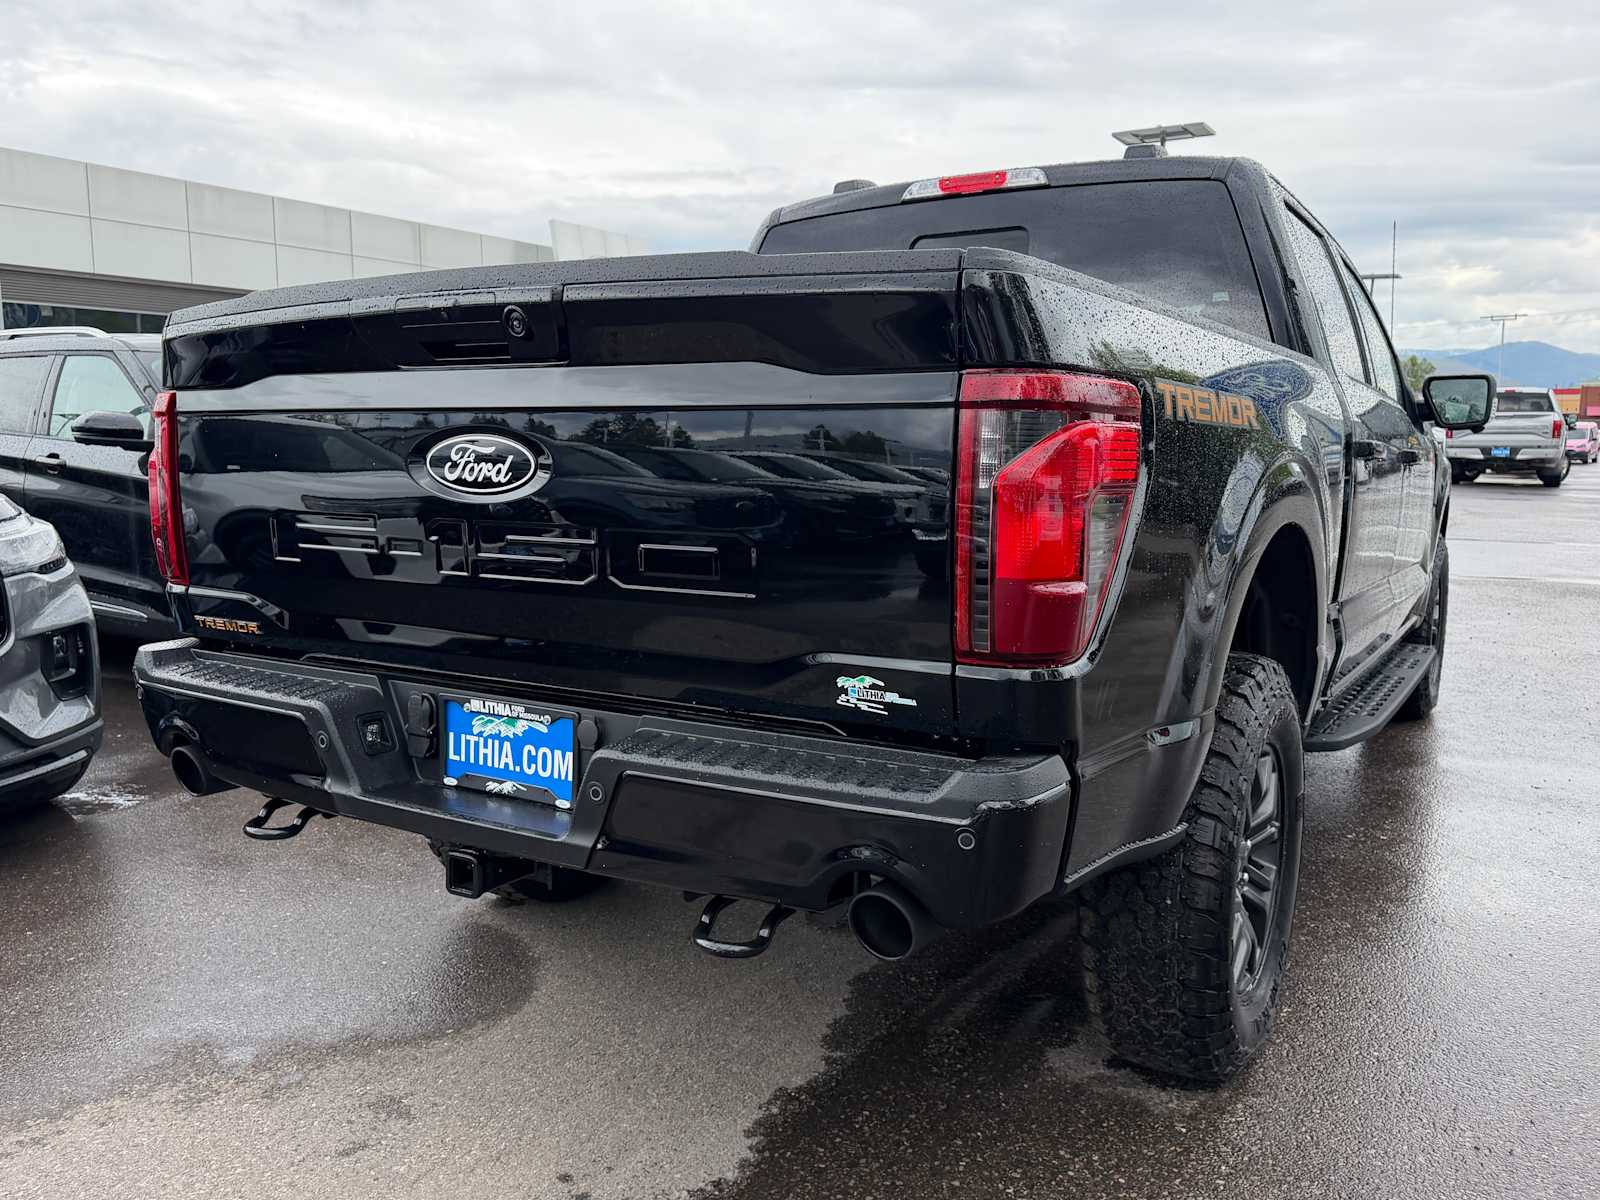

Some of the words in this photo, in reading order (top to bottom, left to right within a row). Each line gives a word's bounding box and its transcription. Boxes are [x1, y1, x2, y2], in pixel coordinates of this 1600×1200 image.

[1155, 380, 1260, 430] TREMOR
[444, 443, 514, 483] Ford
[270, 511, 758, 599] F-150
[193, 614, 264, 635] TREMOR
[480, 700, 511, 717] LITHIA
[857, 689, 886, 702] LITHIA
[448, 731, 574, 782] LITHIA.COM
